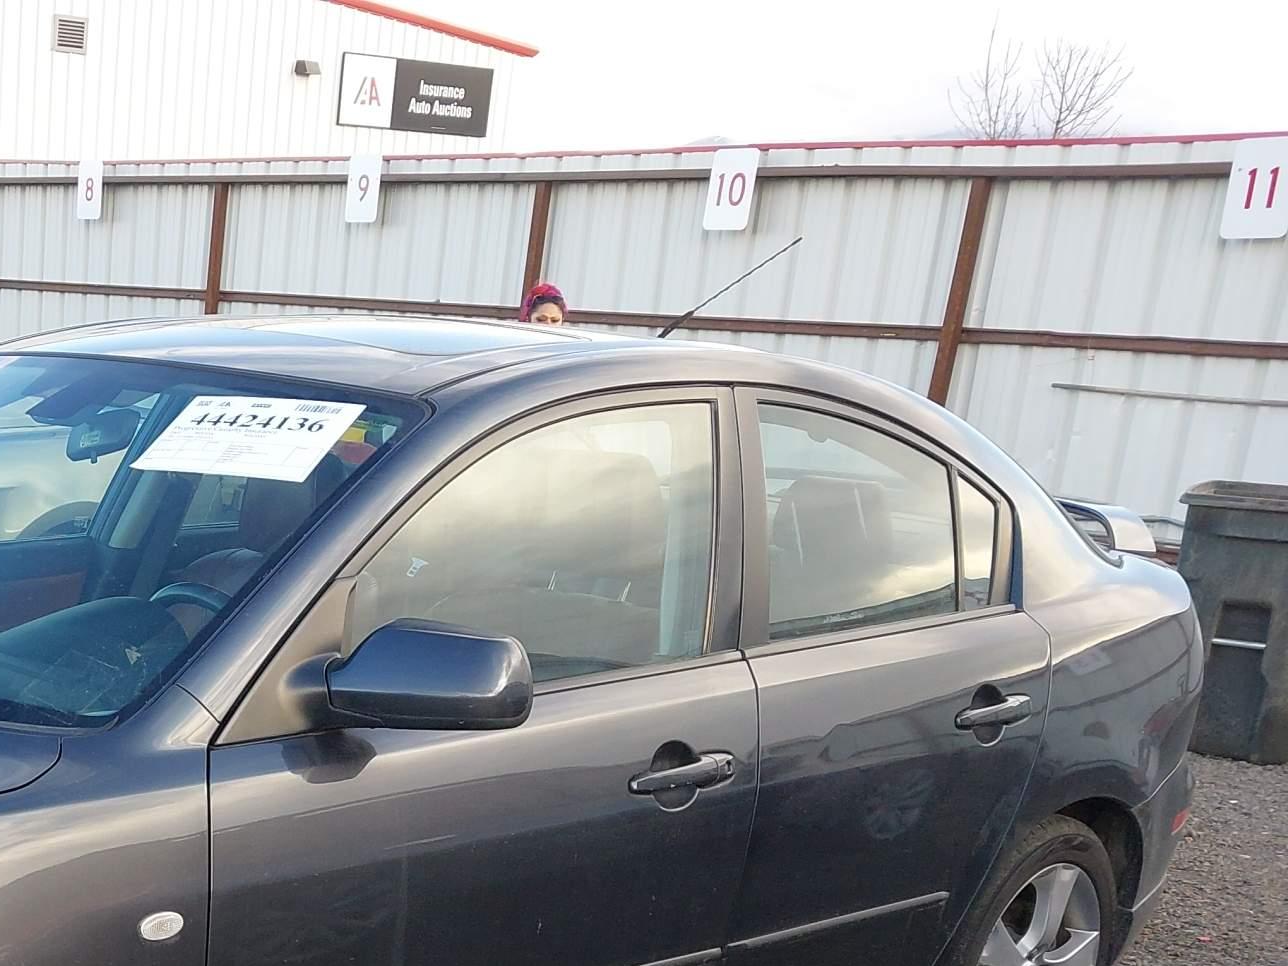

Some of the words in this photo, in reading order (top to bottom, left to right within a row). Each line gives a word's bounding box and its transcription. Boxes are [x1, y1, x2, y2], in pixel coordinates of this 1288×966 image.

[418, 79, 466, 99] Insurance
[408, 97, 430, 115] Auto
[431, 99, 472, 118] Auctions
[85, 178, 94, 202] 8
[358, 174, 370, 202] 9
[716, 172, 746, 207] 10
[1244, 166, 1280, 209] 11
[190, 412, 329, 432] 44424136
